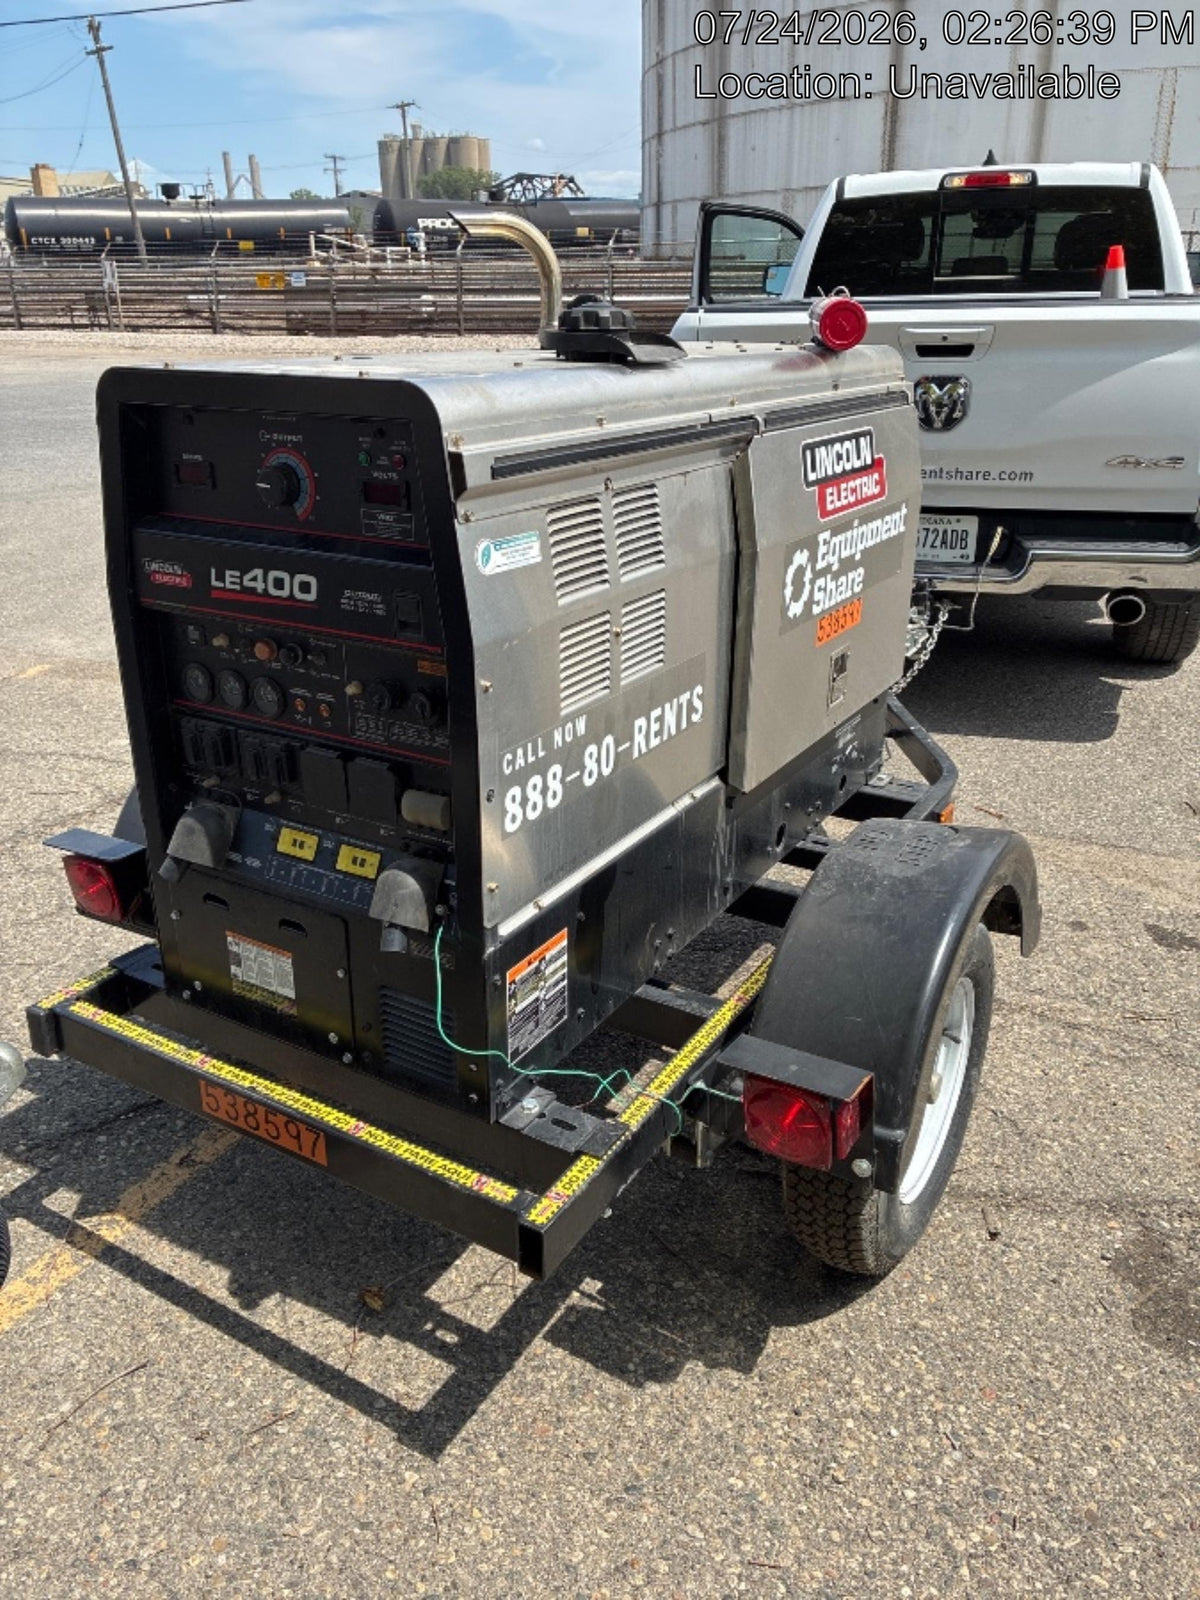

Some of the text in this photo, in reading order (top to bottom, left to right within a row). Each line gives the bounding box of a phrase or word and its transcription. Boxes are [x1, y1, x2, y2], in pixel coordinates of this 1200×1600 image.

[805, 434, 873, 482] LINCOLN
[825, 473, 881, 511] ELECTRIC
[815, 502, 908, 571] Equipment
[916, 527, 969, 550] 72ADB
[210, 566, 318, 602] LE400
[812, 567, 866, 616] Share
[502, 713, 588, 776] CALL NOW
[503, 683, 704, 834] 888-80-RENTS
[204, 1080, 321, 1158] 538597
[363, 1127, 385, 1143] NO
[385, 1137, 405, 1152] SE
[403, 1146, 437, 1168] PARE
[561, 1173, 581, 1193] DO
